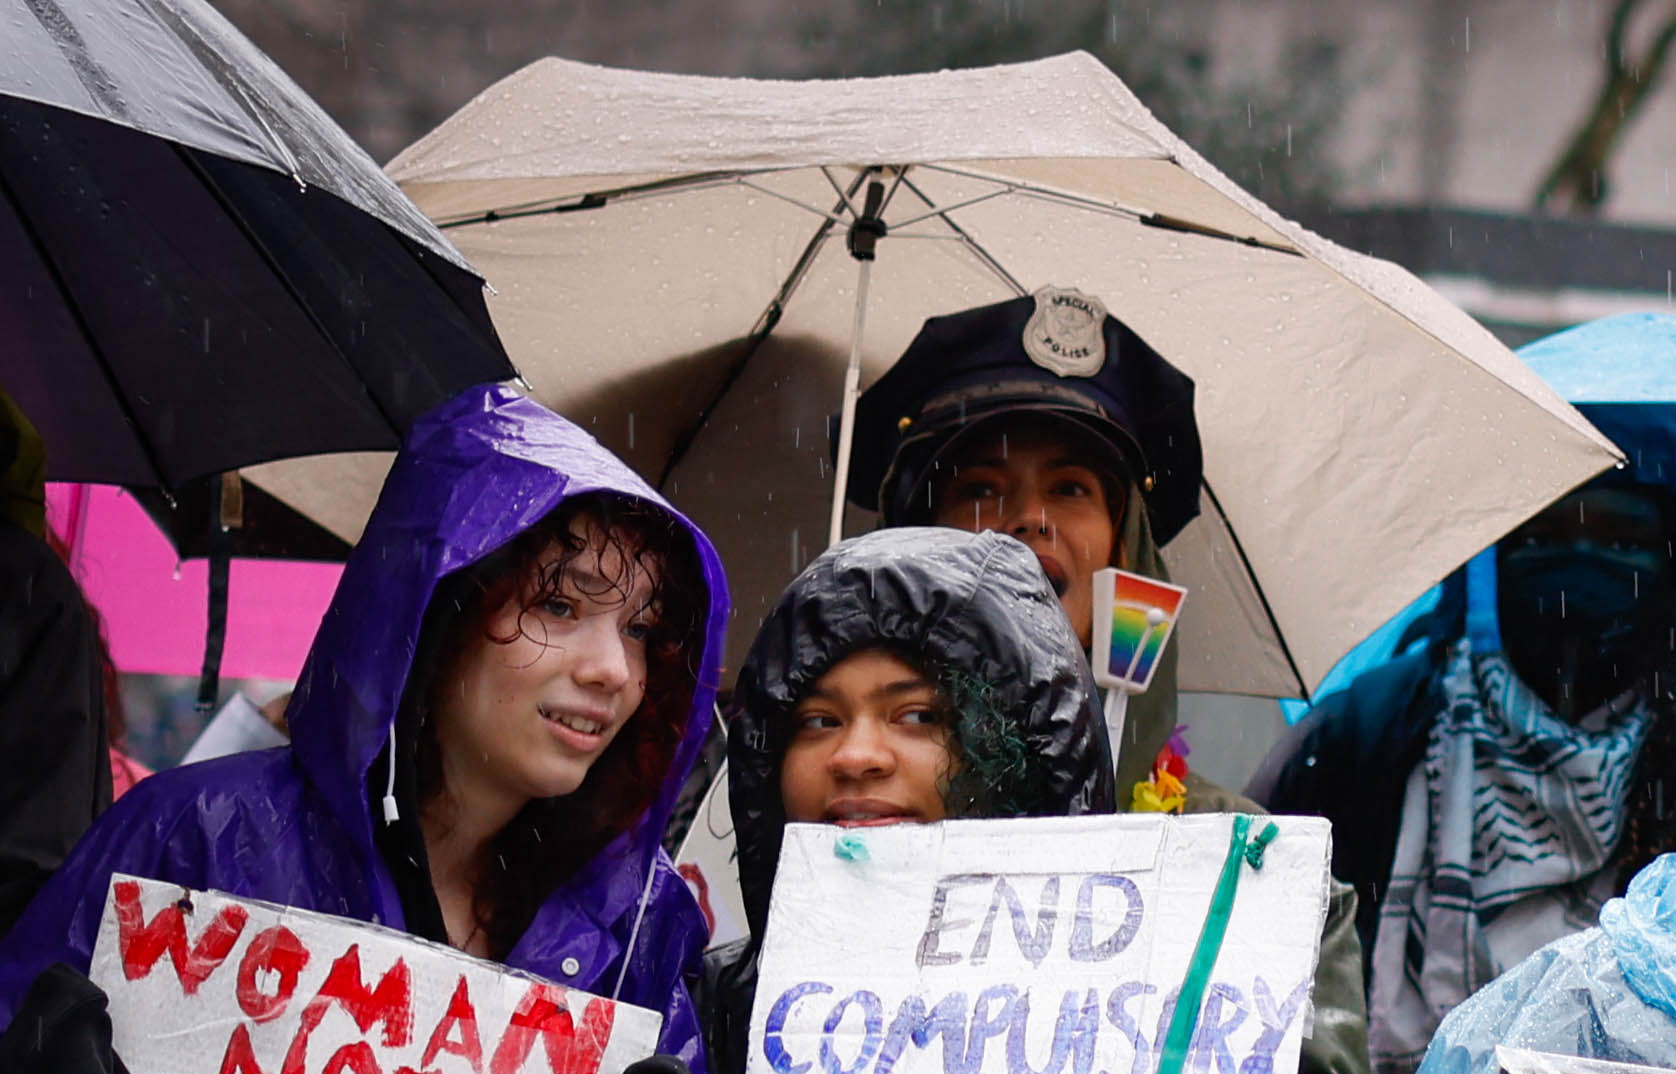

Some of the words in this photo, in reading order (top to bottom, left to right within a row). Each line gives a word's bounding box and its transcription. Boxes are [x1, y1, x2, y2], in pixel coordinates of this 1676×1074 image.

[1051, 295, 1094, 319] SPECIAL
[1043, 336, 1090, 358] POLICE
[916, 872, 1146, 968] END
